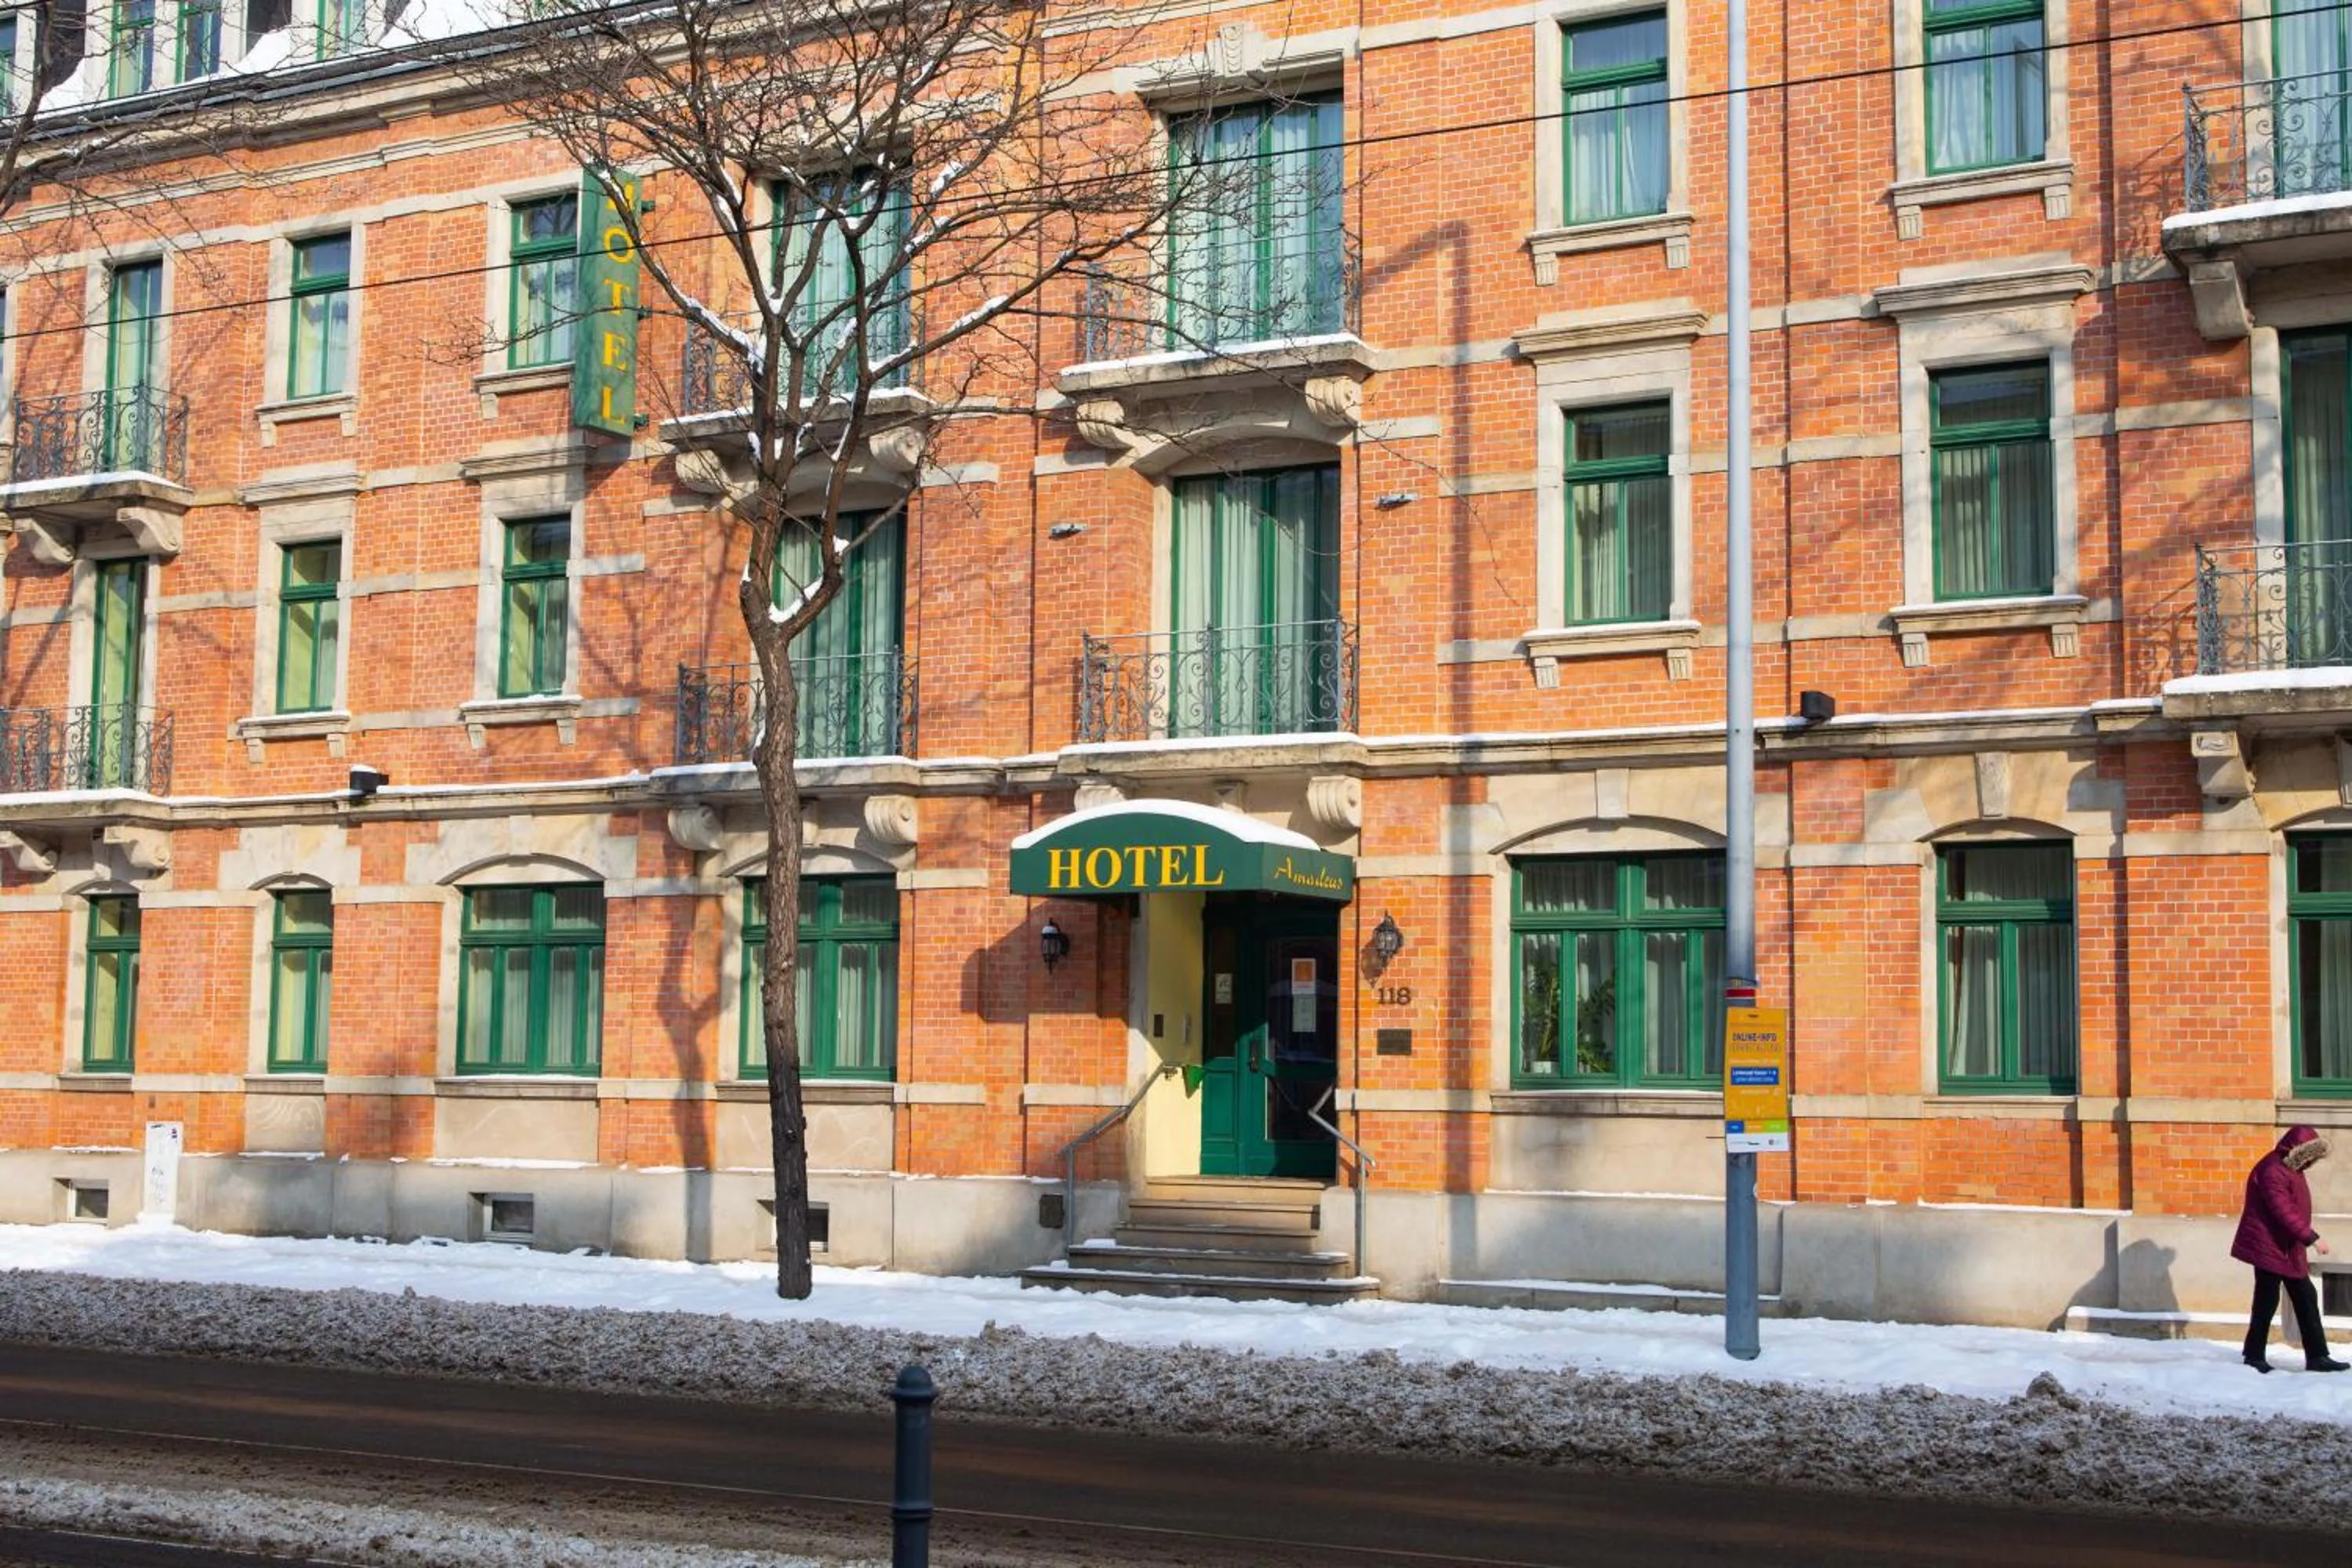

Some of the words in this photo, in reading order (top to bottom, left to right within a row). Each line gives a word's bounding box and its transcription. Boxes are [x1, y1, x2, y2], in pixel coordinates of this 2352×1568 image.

[1047, 844, 1225, 889] HOTEL
[1273, 854, 1343, 891] Amadeus
[1377, 987, 1410, 1005] 118
